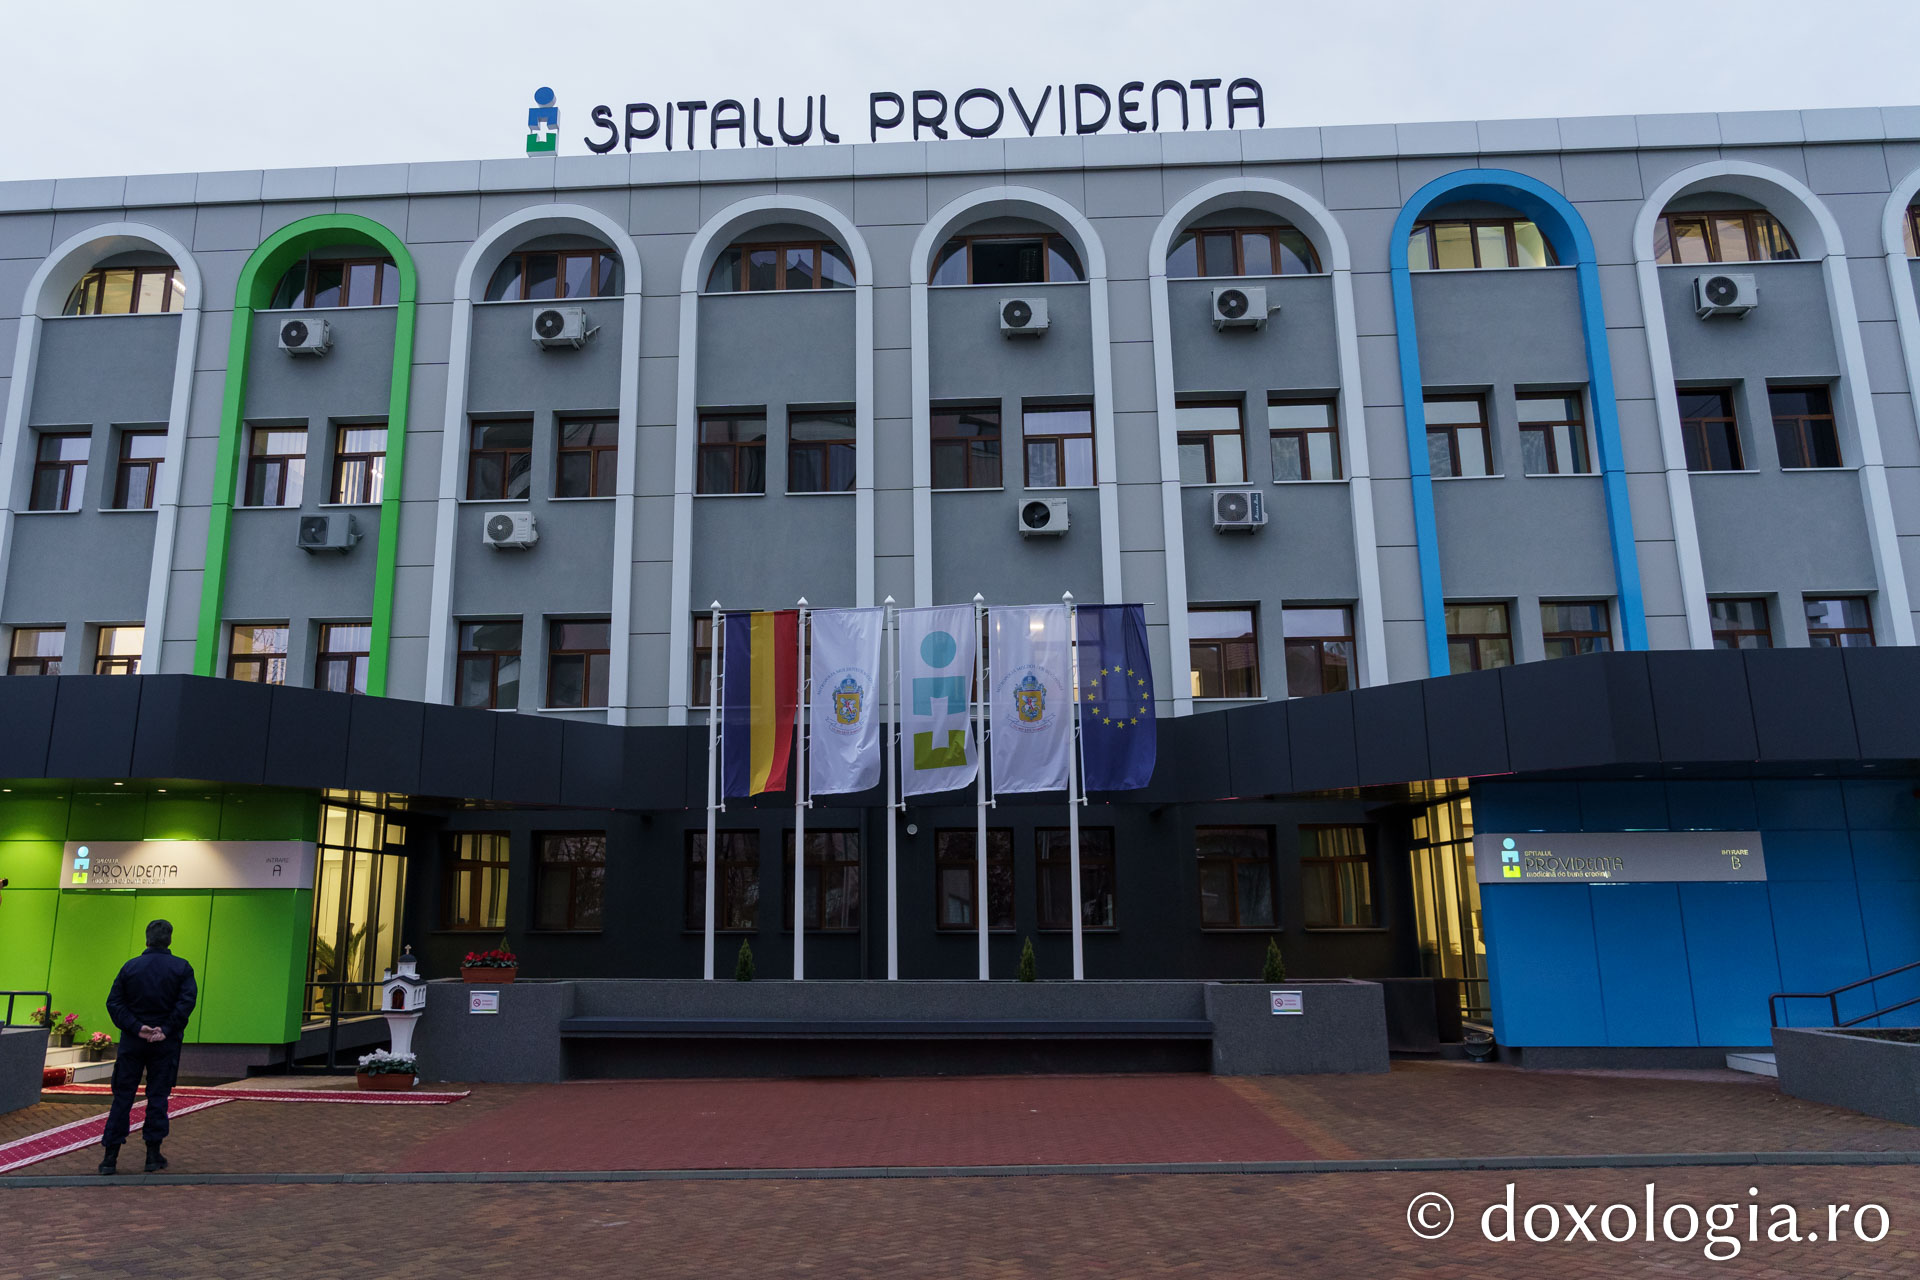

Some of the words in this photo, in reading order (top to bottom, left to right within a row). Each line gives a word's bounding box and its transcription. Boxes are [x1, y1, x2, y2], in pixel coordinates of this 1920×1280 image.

[583, 94, 839, 154] SPITALUL
[870, 77, 1265, 142] PROVIDENTA
[1525, 857, 1624, 871] PROVIDENTA
[1731, 855, 1742, 870] B
[92, 864, 178, 878] PROVIDENTA
[272, 864, 282, 877] A
